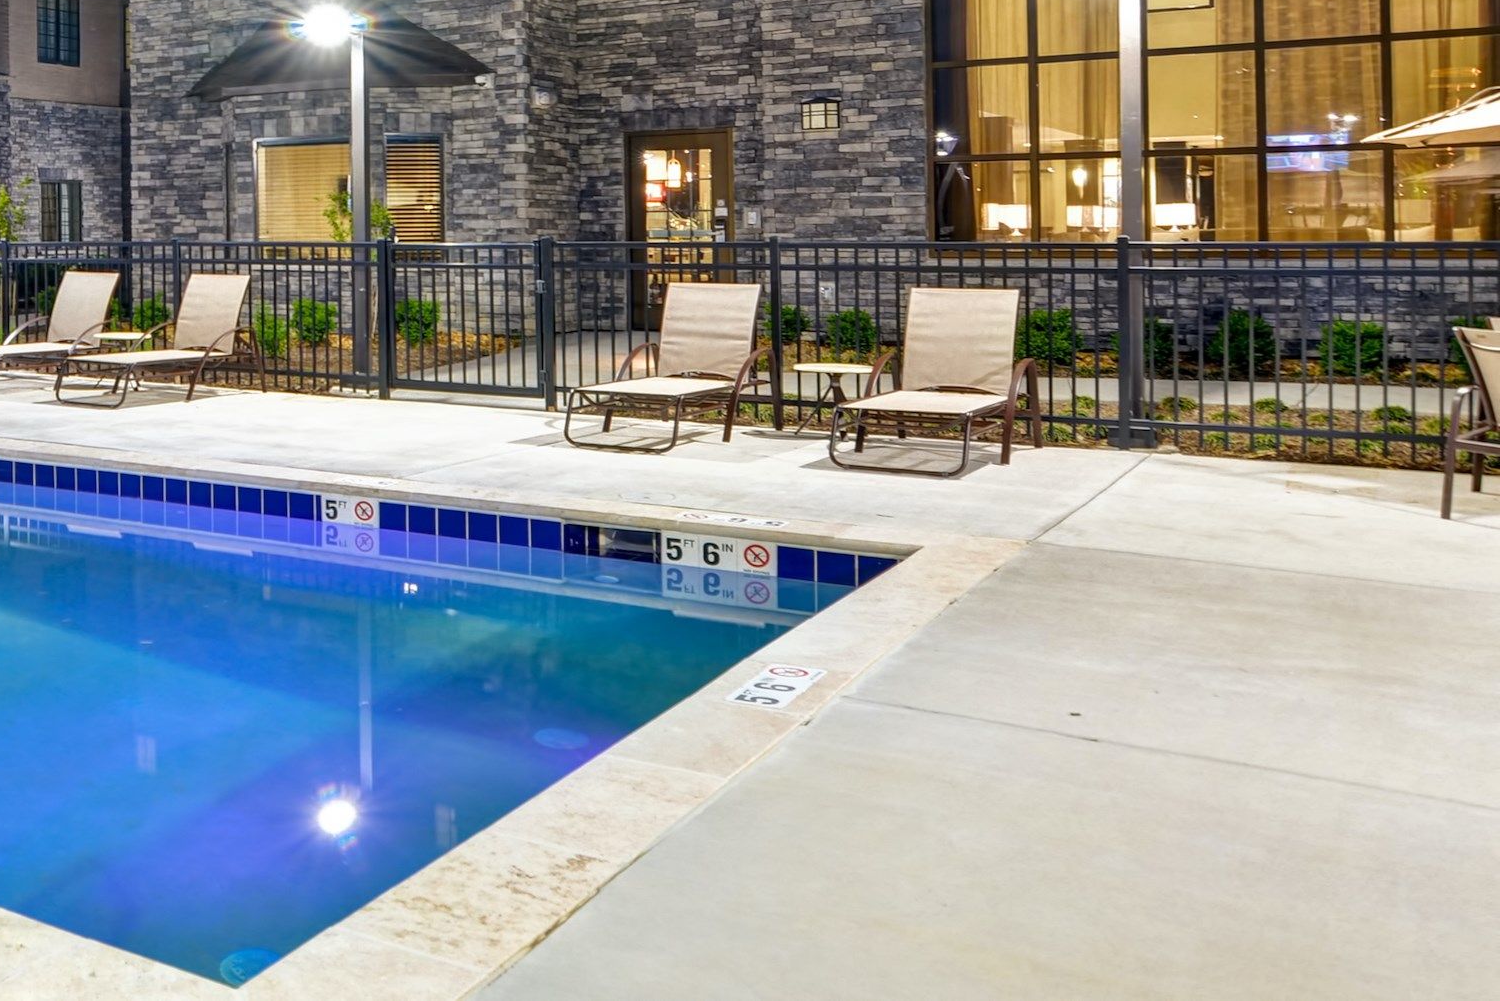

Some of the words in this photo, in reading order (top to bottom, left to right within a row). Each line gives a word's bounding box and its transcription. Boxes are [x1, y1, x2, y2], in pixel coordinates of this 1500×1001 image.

[325, 500, 338, 520] 5
[338, 501, 347, 509] FT
[666, 537, 683, 561] 5
[683, 539, 695, 548] FT
[703, 542, 720, 566] 6
[722, 544, 733, 553] IN
[754, 682, 796, 692] 6
[735, 693, 780, 705] 5
